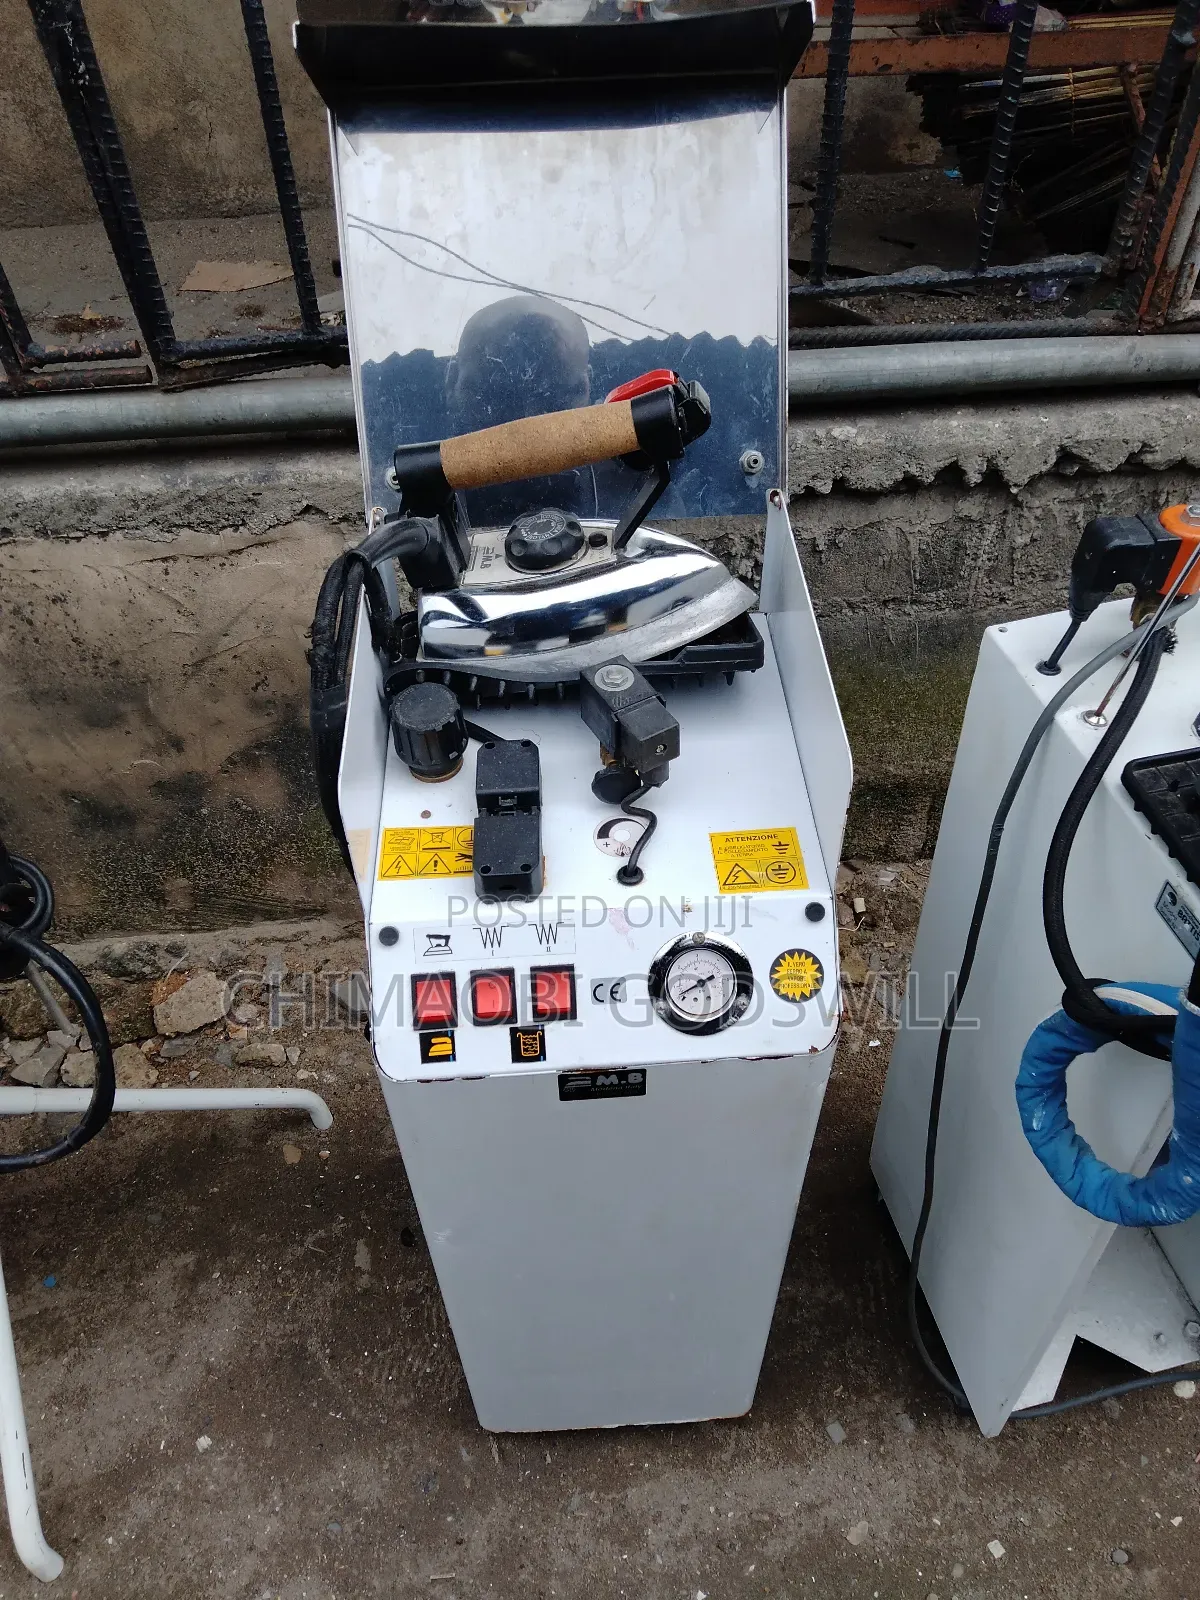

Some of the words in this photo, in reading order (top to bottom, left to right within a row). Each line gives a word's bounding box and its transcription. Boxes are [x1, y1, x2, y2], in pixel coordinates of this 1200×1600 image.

[725, 834, 779, 842] ATTENZIONE
[593, 983, 622, 1004] CE
[596, 1072, 644, 1086] M.B
